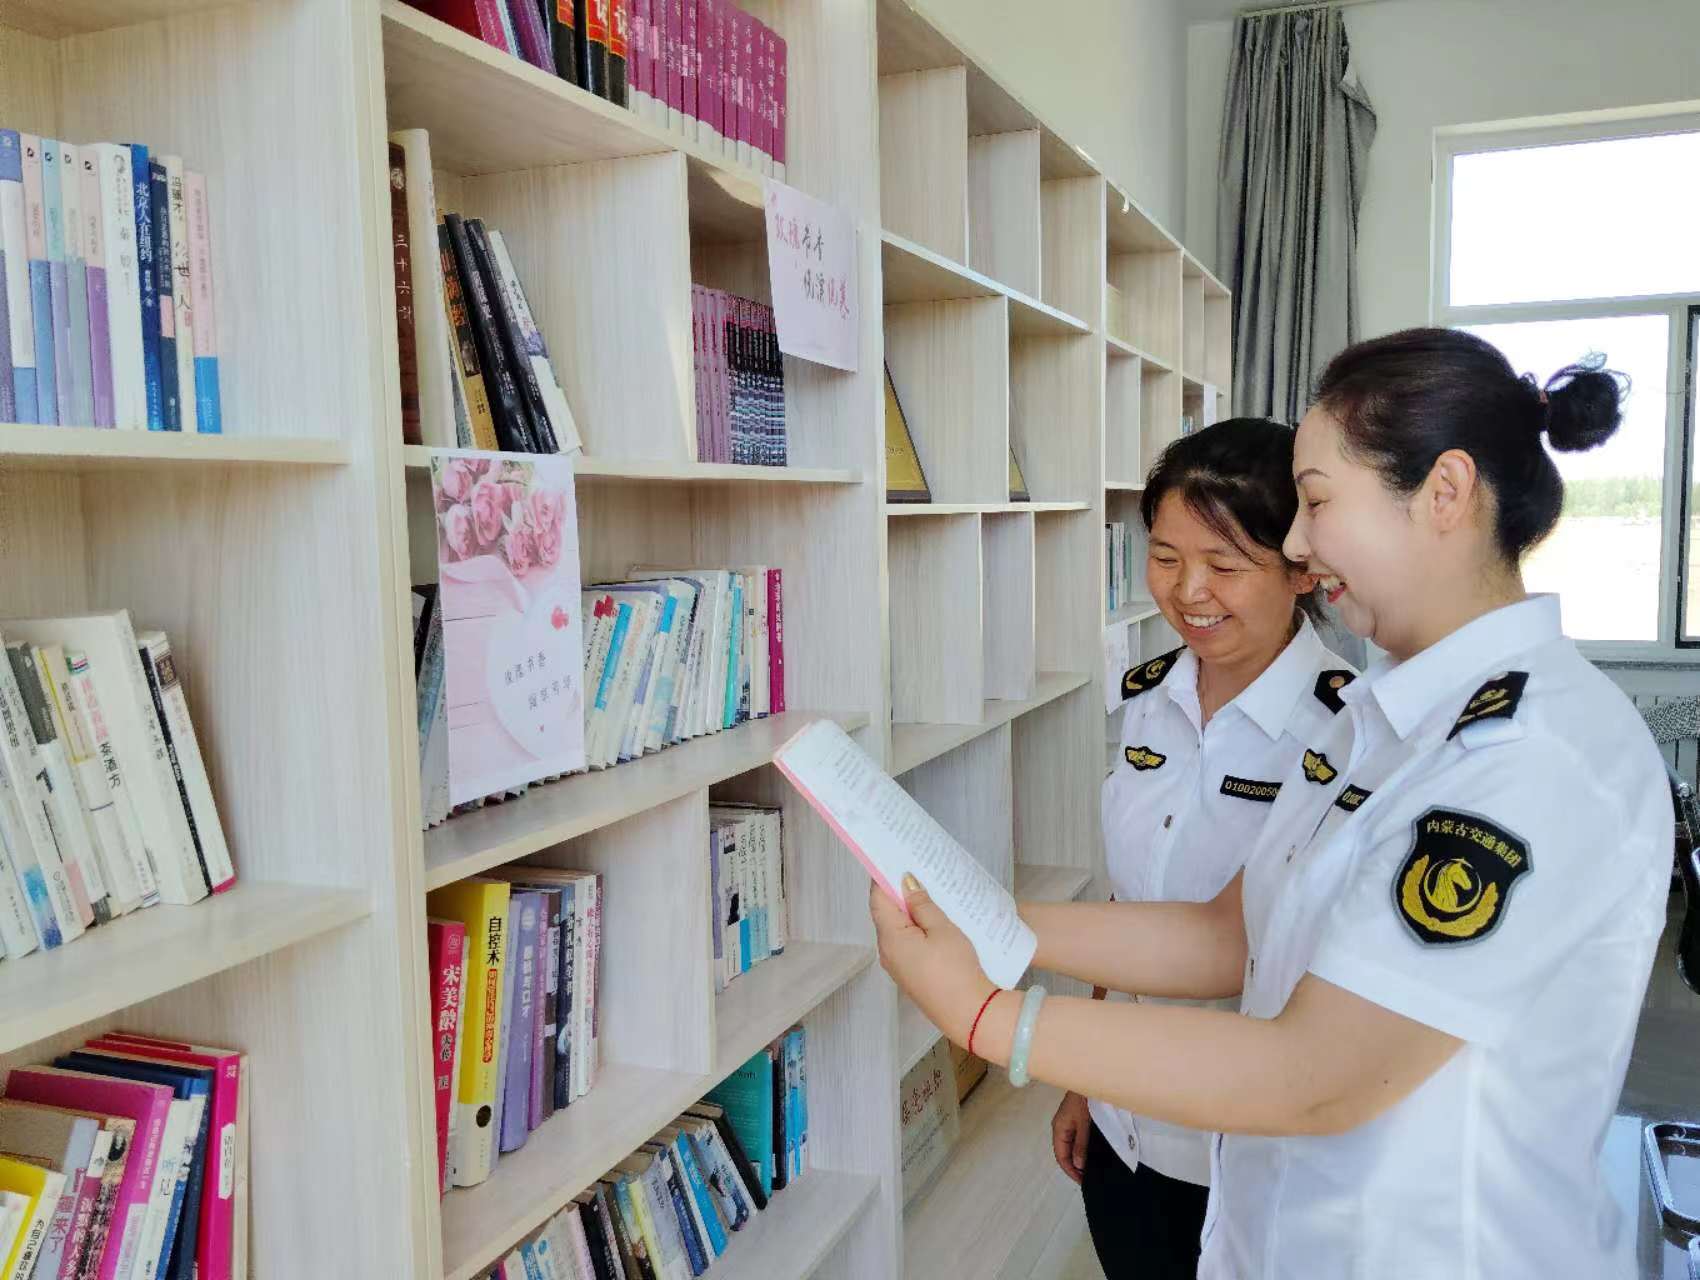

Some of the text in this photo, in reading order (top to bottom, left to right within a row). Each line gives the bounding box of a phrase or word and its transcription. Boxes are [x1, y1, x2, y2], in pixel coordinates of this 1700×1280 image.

[1426, 819, 1522, 868] 内蒙古交通集团
[438, 964, 461, 1031] 宋美龄
